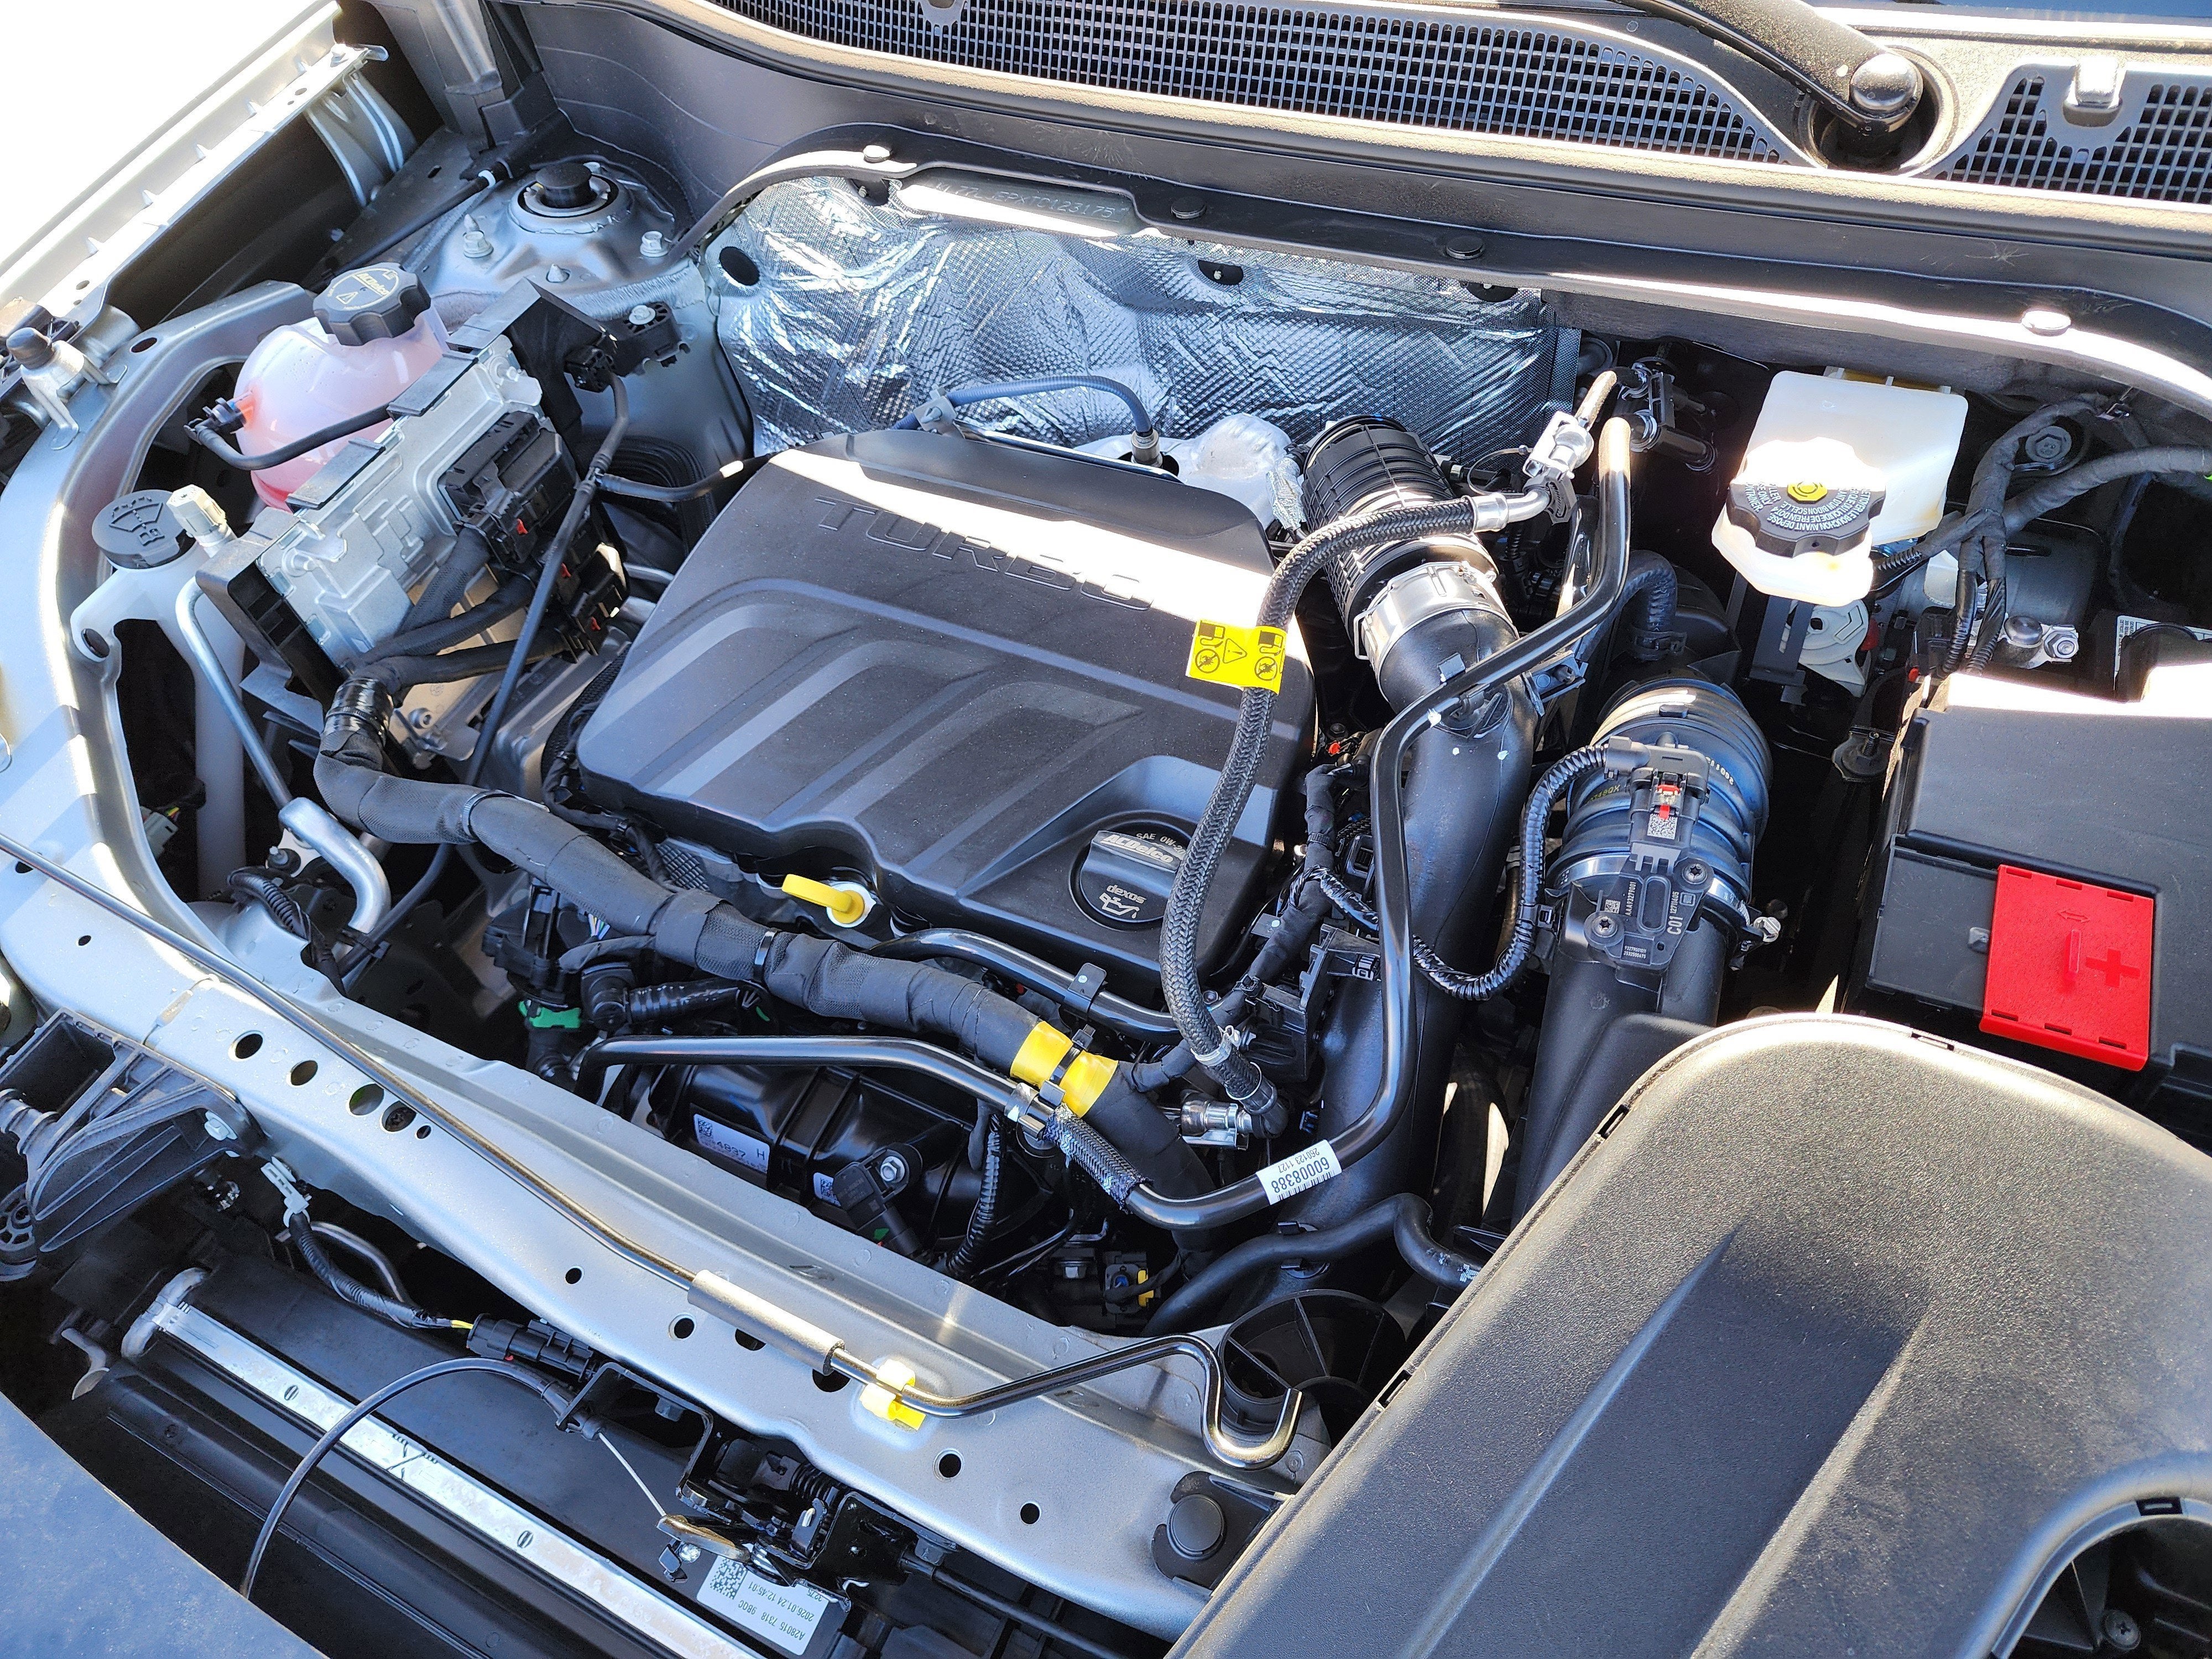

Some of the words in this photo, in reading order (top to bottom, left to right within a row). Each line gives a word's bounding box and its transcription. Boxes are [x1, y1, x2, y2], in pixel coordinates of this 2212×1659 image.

[1758, 491, 1773, 505] ONLY
[1774, 508, 1791, 519] DOT
[1808, 504, 1828, 515] BIDON
[1820, 508, 1846, 521] LIQUIDE
[1848, 508, 1859, 519] LE
[1788, 513, 1809, 523] FREIN
[1819, 514, 1853, 531] BOUCHON
[1794, 522, 1819, 531] AVANT
[815, 496, 1155, 611] TURBO
[1102, 834, 1173, 863] ACDelco
[1107, 885, 1147, 904] dexos
[756, 1148, 765, 1161] H
[1295, 1147, 1320, 1165] 260123
[1277, 1160, 1294, 1173] 1127
[1271, 1157, 1330, 1193] 60008388
[748, 1580, 776, 1602] 12:45:01
[777, 1596, 815, 1622] 2026.01.24
[761, 1611, 778, 1626] 7318
[779, 1621, 806, 1641] A28015
